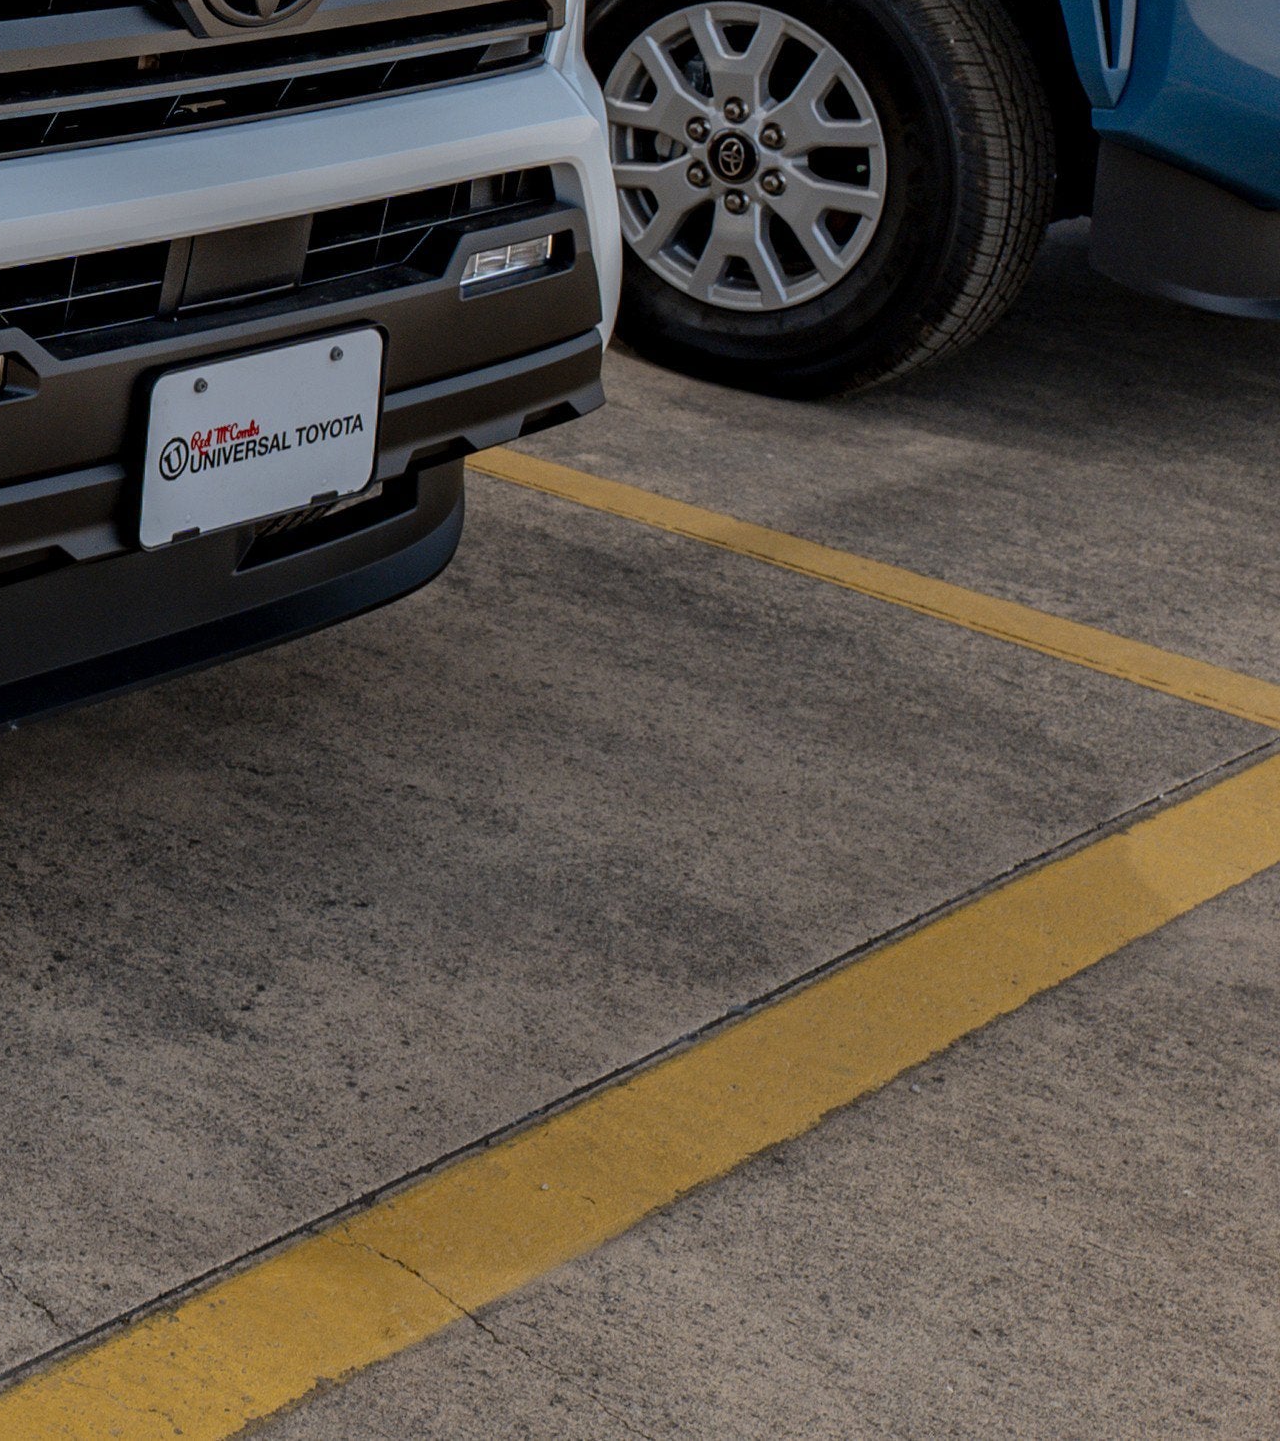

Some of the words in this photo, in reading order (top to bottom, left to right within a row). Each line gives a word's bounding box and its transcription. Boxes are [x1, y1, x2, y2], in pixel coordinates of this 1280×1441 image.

[190, 431, 292, 474] UNIVERSAL
[295, 413, 364, 447] TOYOTA
[191, 429, 213, 454] Red
[214, 419, 260, 443] McCombs
